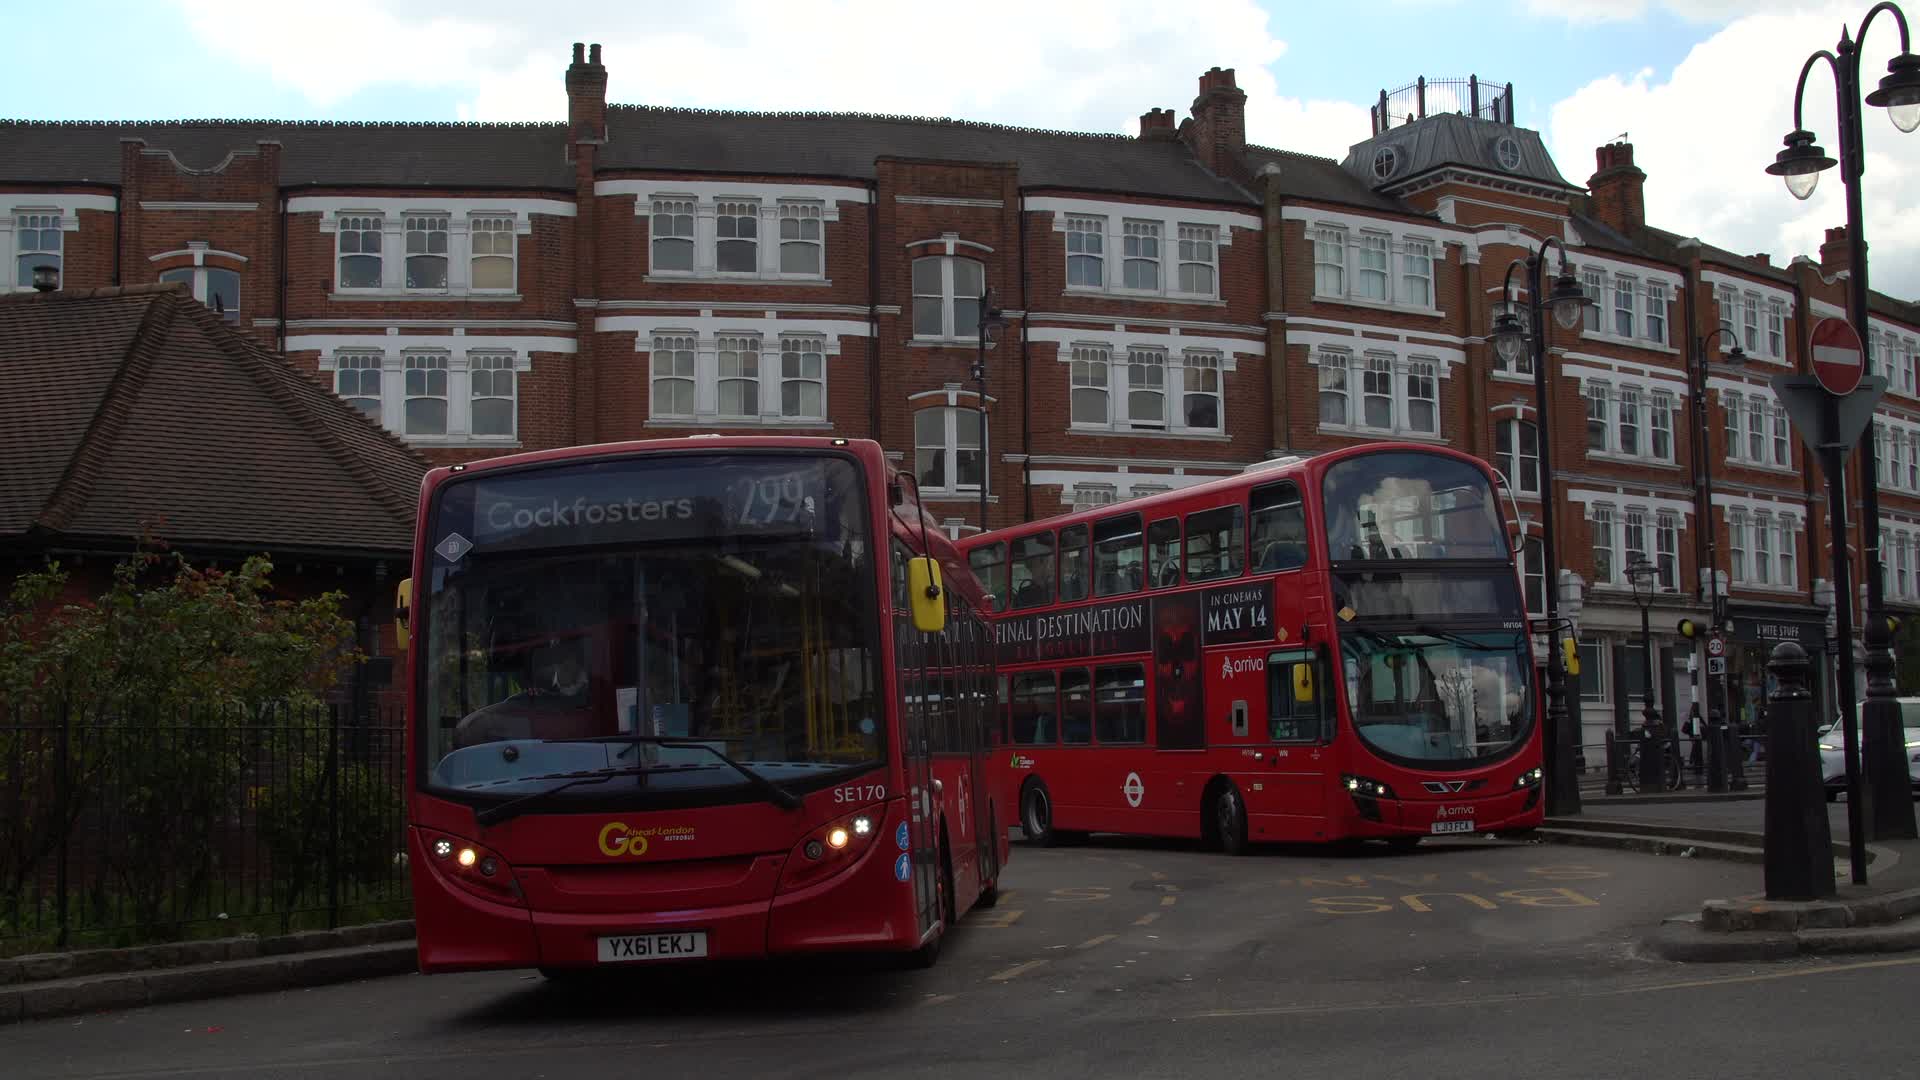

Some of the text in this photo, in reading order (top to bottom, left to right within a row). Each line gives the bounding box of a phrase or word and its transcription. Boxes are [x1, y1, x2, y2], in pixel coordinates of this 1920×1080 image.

[738, 475, 804, 526] 299
[487, 497, 693, 530] Cockfosters
[1210, 589, 1263, 606] IN CINEMAS
[995, 619, 1033, 645] FINAL
[1038, 604, 1143, 639] DESTINATION
[1207, 604, 1267, 633] MAY 14
[1779, 625, 1799, 637] STUFF
[1710, 641, 1721, 650] 20
[1234, 655, 1264, 672] arriva
[834, 785, 885, 803] SE170
[599, 821, 648, 857] Go
[609, 934, 695, 957] YX61 EKJ
